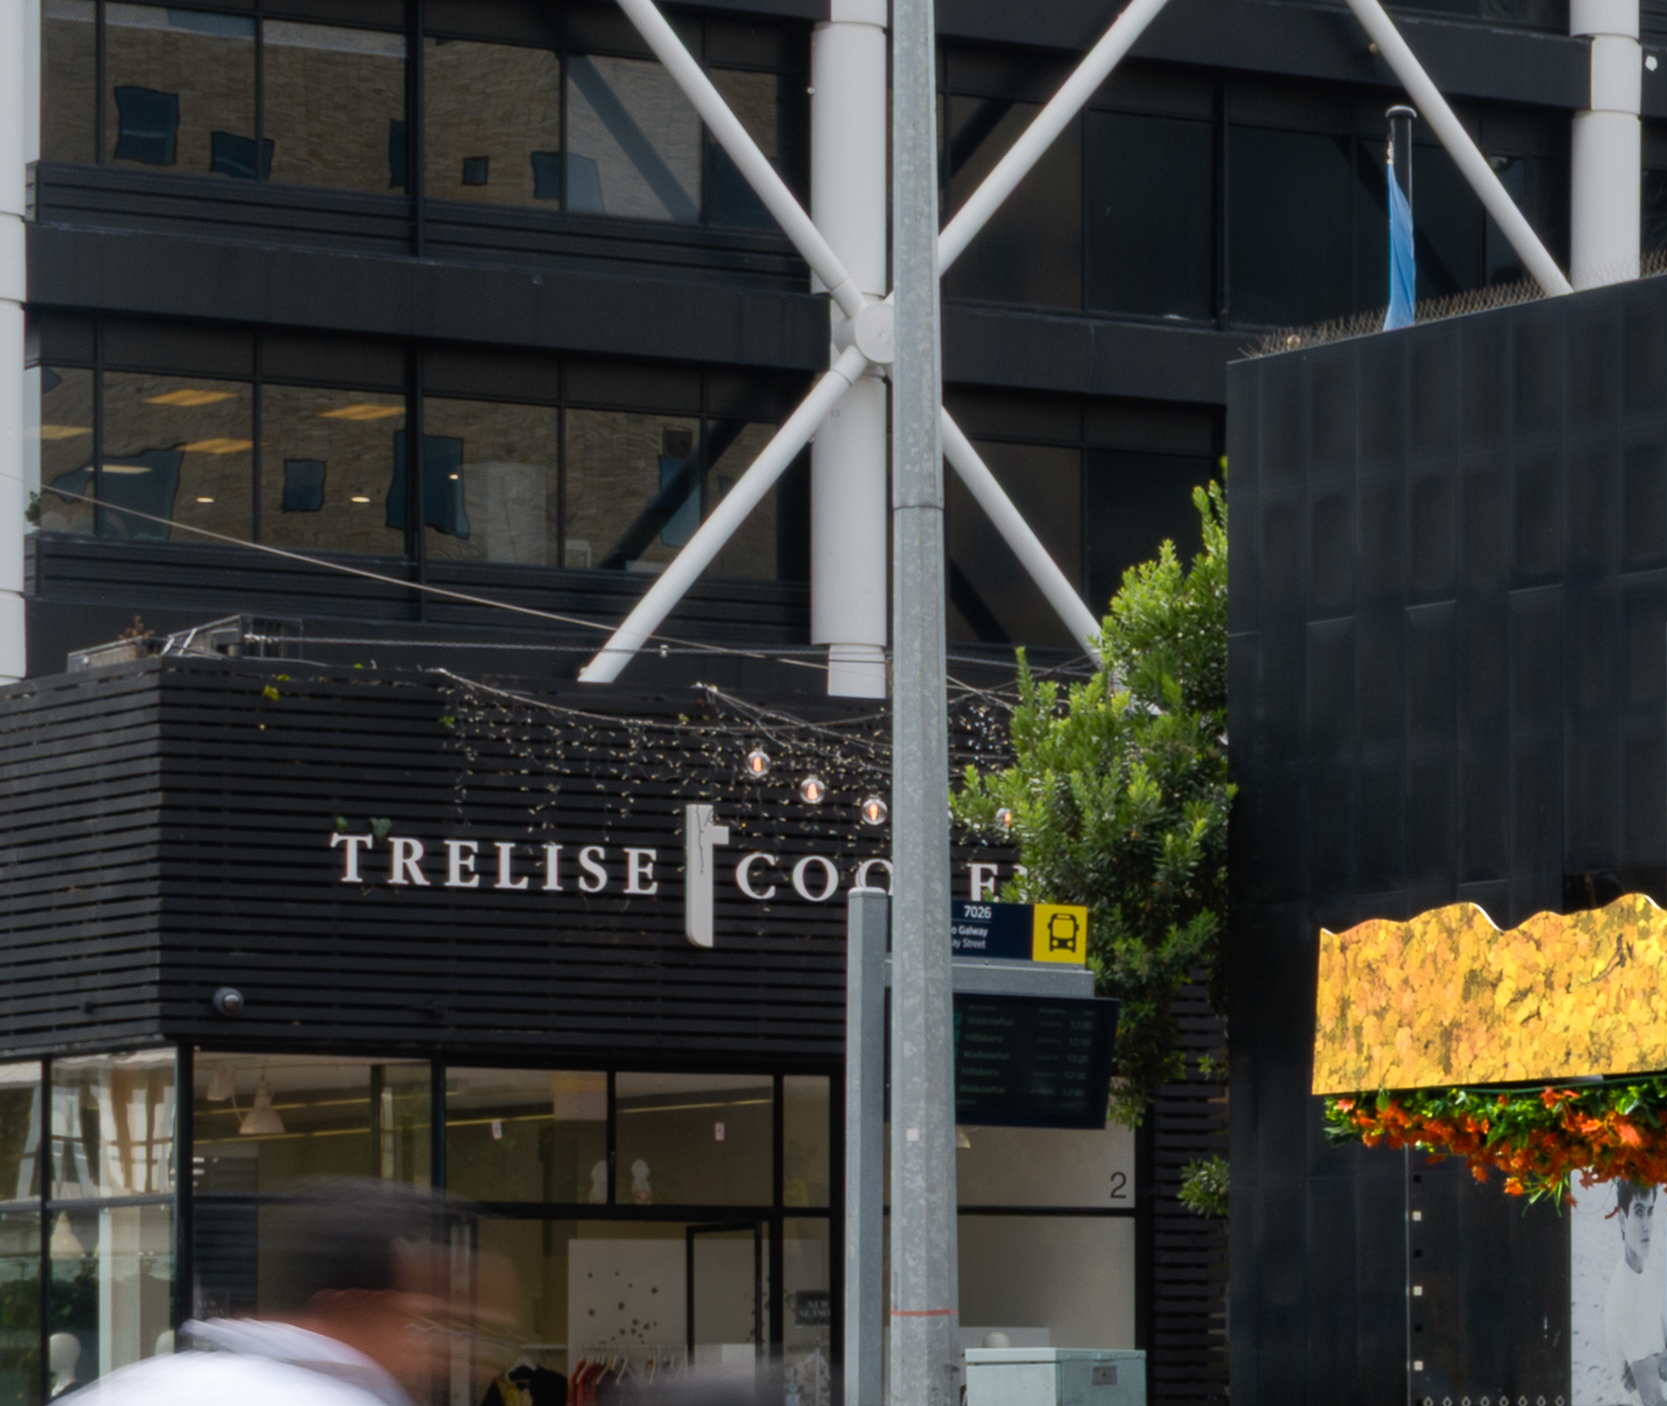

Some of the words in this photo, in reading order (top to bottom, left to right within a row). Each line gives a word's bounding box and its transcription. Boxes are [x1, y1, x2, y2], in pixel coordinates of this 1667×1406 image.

[330, 832, 659, 895] TRELISE
[963, 904, 992, 919] 7026
[1110, 1171, 1126, 1199] 2
